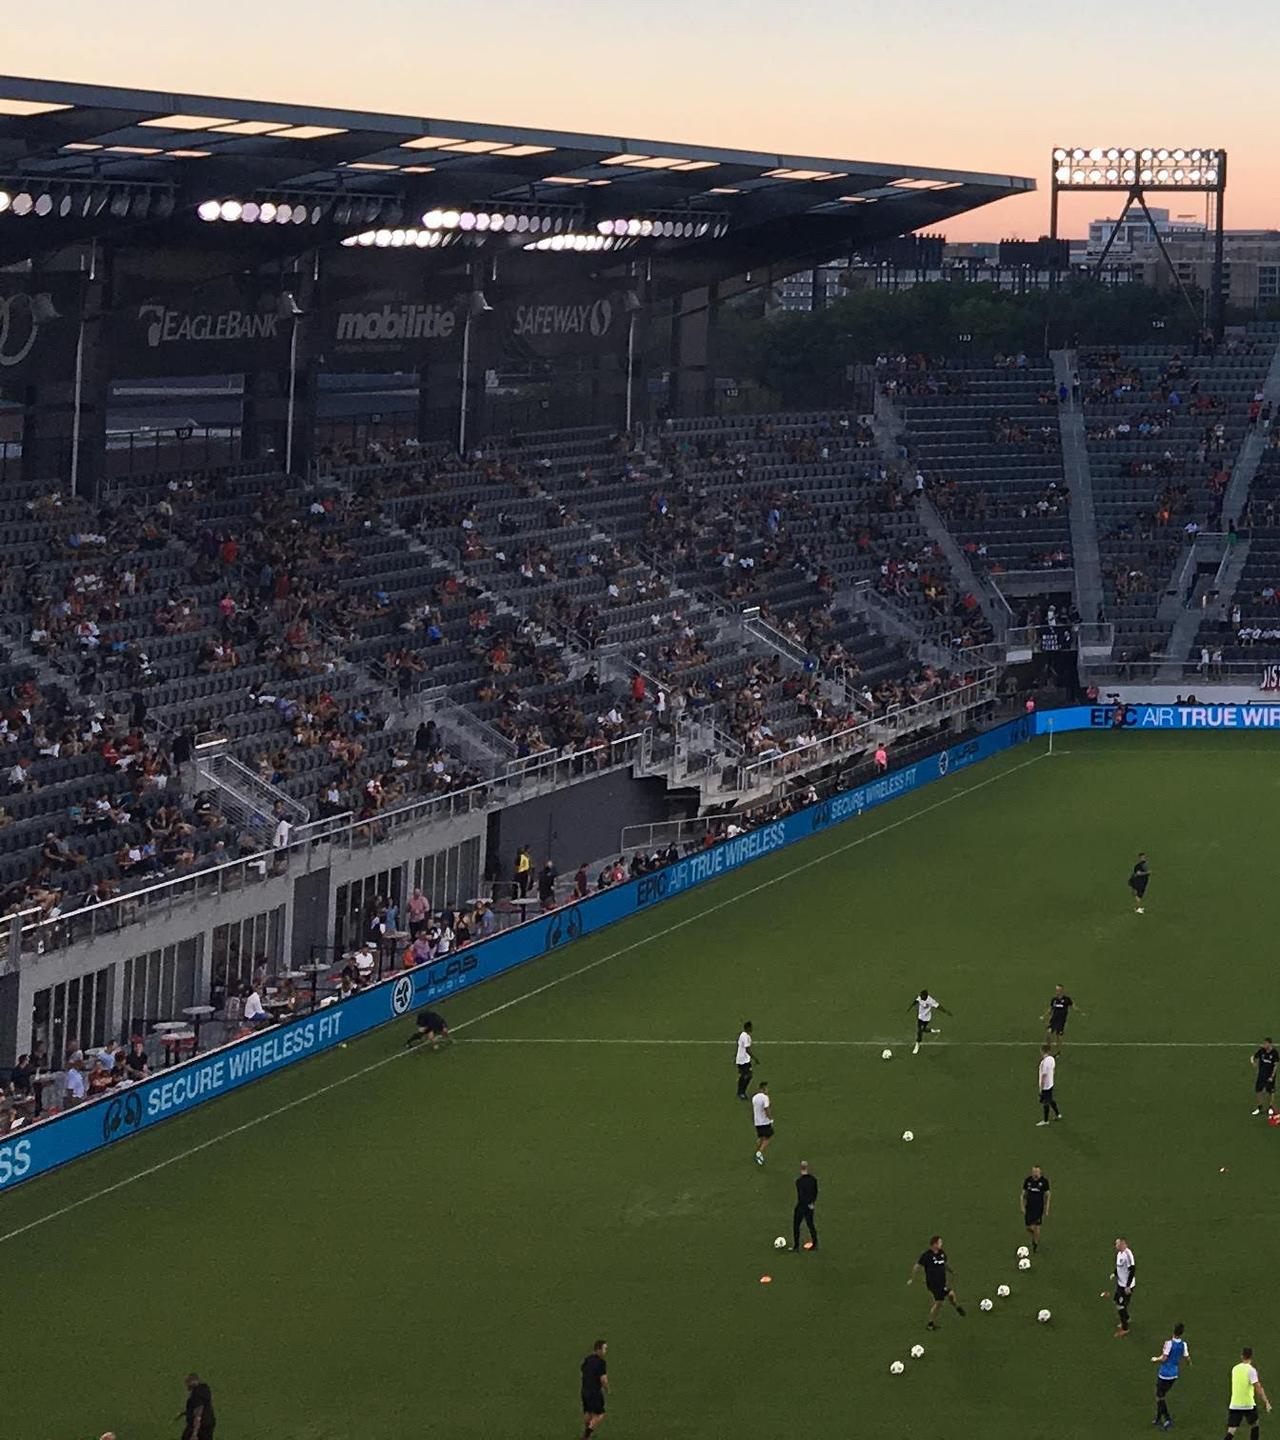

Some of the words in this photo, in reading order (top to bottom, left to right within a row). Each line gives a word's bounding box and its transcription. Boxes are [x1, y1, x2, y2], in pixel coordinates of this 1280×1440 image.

[337, 304, 455, 339] mobilitie
[513, 305, 591, 335] SAFEWAY
[1091, 708, 1137, 726] EPC
[1142, 707, 1174, 726] AIR
[1178, 707, 1237, 726] TRUE
[637, 873, 667, 907] EPIC
[668, 861, 689, 893] AIR
[690, 847, 724, 883] TRUE
[725, 822, 785, 867] WIRELESS
[147, 1062, 225, 1116] SECURE
[228, 1023, 315, 1081] WIRELESS
[319, 1010, 344, 1042] FIT
